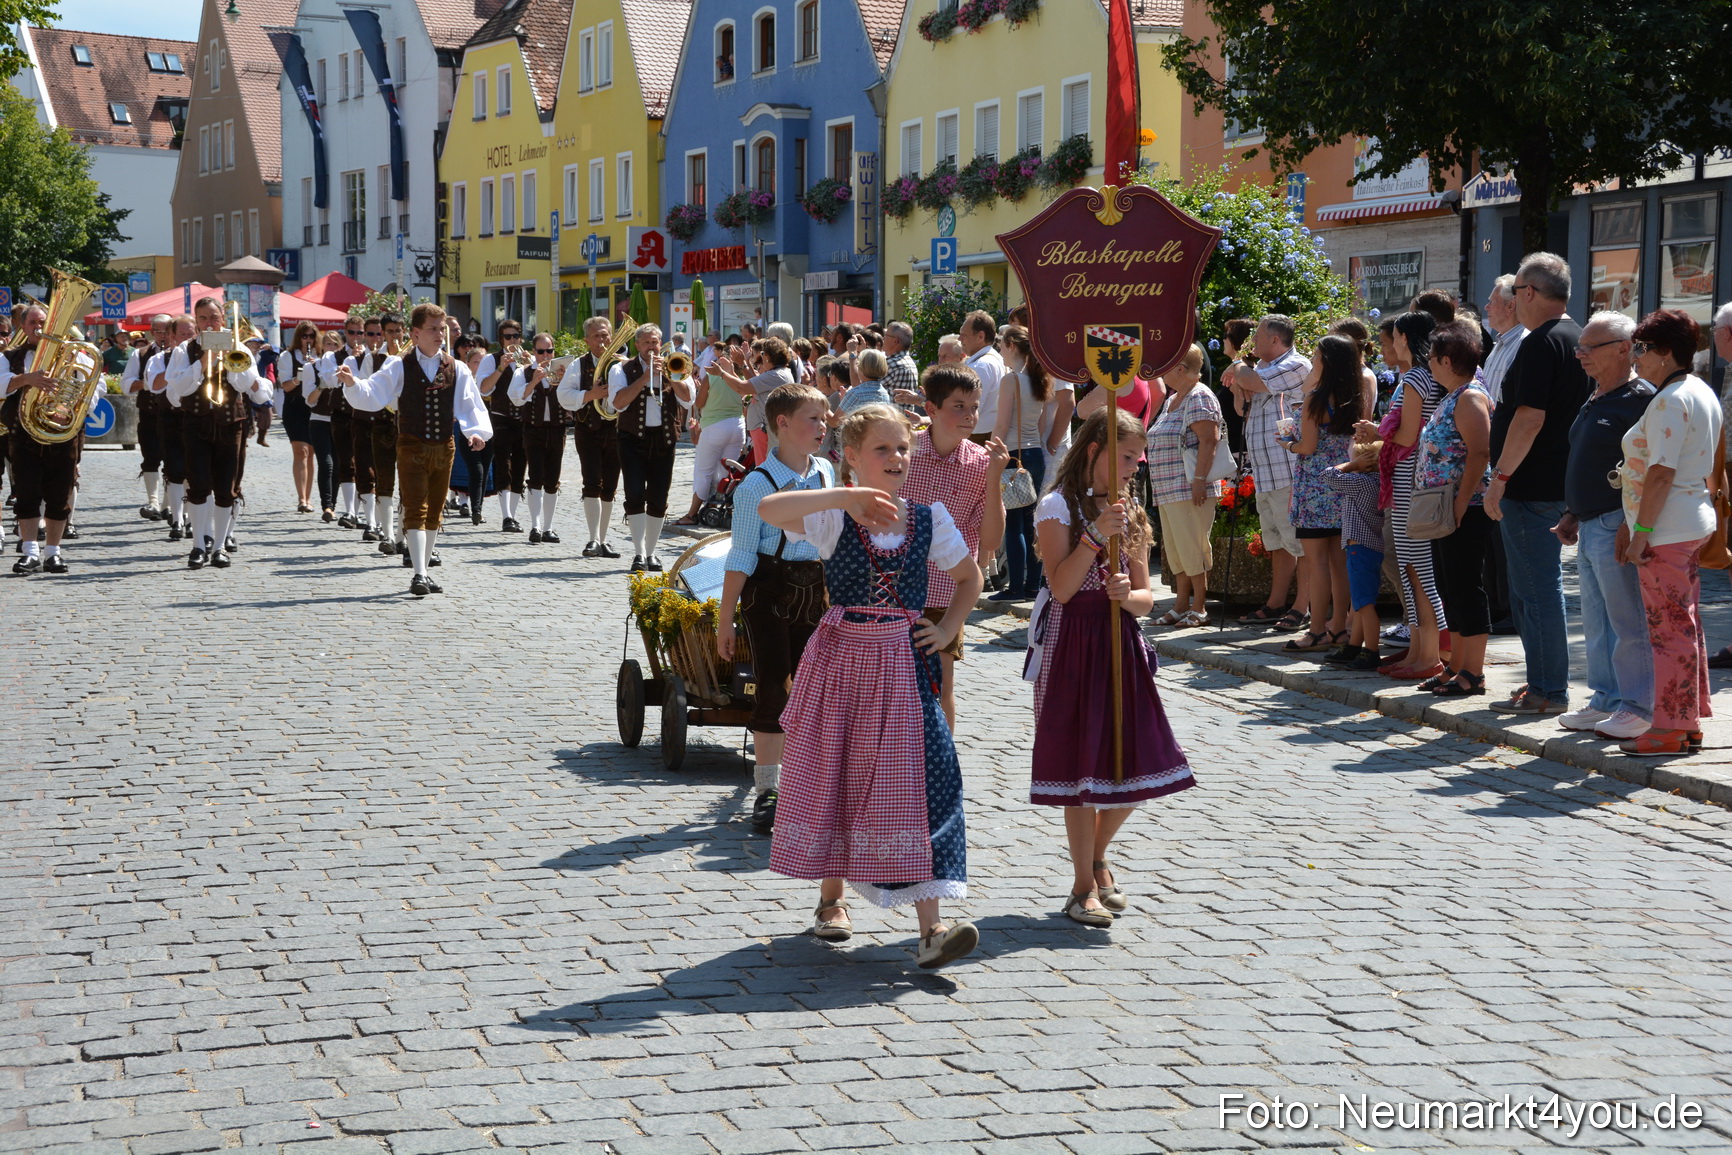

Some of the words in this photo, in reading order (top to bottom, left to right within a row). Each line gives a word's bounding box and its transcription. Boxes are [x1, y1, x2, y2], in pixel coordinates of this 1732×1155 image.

[486, 145, 513, 169] HOTEL
[518, 142, 548, 162] Lehmeier
[858, 153, 875, 169] CAFÉ
[1356, 179, 1394, 196] Italienische
[1395, 177, 1425, 191] Feinkost
[859, 171, 873, 246] WITTL
[552, 214, 558, 239] P
[519, 249, 550, 258] TAIFUN
[589, 238, 595, 263] P
[680, 245, 748, 275] APOTHEKE
[936, 241, 951, 271] P
[1037, 239, 1184, 271] Blaskapelle
[485, 260, 521, 278] Restaurant
[1355, 265, 1378, 278] MARIO
[1378, 262, 1419, 276] NIESSLBECK
[1058, 272, 1164, 306] Berngau
[104, 307, 125, 316] TAXI
[1064, 331, 1077, 344] 19
[1149, 329, 1162, 341] 73
